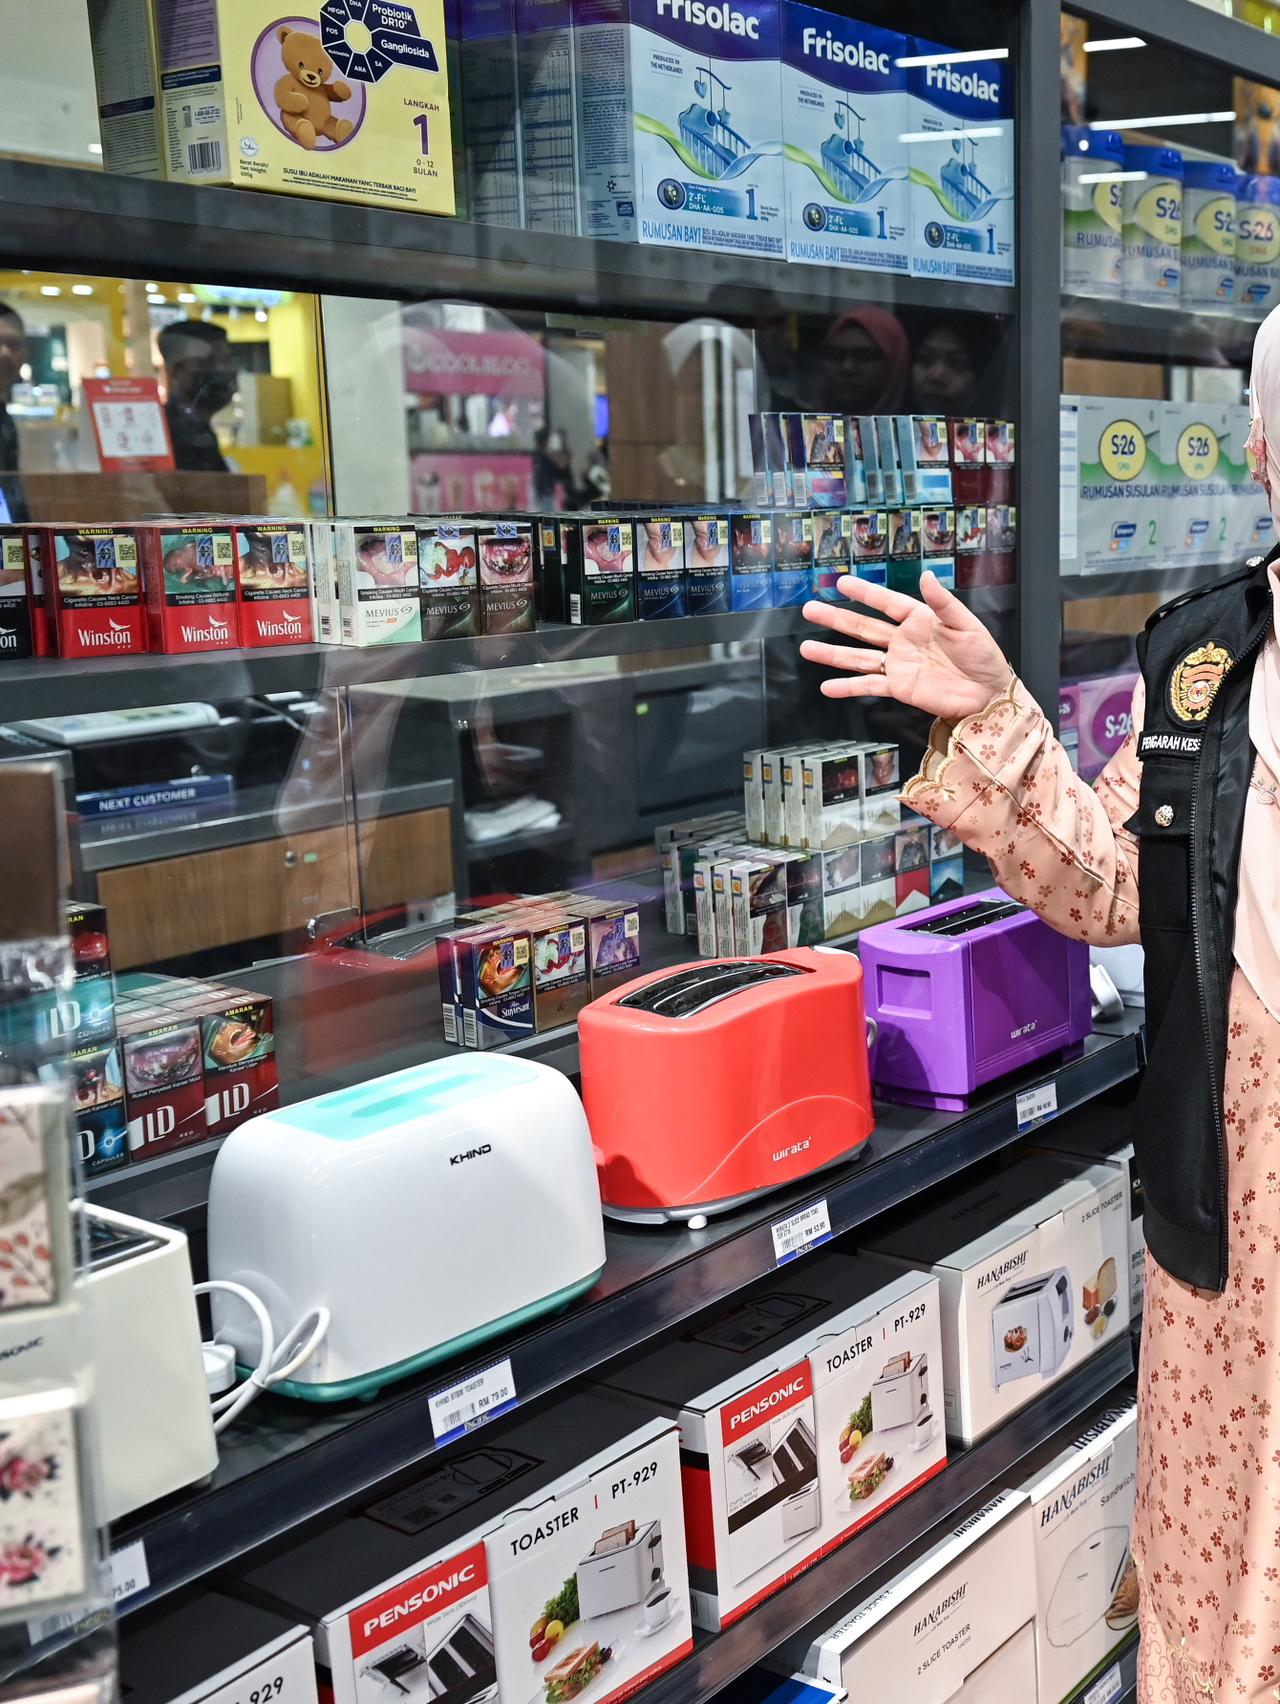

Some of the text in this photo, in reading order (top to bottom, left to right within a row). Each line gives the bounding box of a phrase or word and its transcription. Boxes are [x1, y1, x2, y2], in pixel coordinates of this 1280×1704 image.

[372, 4, 412, 21] Probiotik
[657, 0, 759, 40] Frisolac
[326, 27, 338, 35] FOS
[381, 39, 429, 58] Gangliosida
[803, 28, 890, 75] Frisolac
[354, 65, 366, 73] ARA
[926, 62, 999, 103] Frisolac
[404, 98, 440, 112] LANGKAH
[413, 114, 429, 156] 1
[283, 168, 298, 176] SUSU
[308, 172, 330, 180] ADALAH
[330, 174, 357, 184] MAKANAN
[414, 167, 438, 177] BULAN
[746, 188, 758, 221] 1
[643, 220, 683, 241] RUMUSAN
[684, 226, 700, 244] BAYI
[877, 210, 887, 240] 1
[791, 242, 824, 260] RUMUSAN
[987, 228, 996, 255] 1
[1082, 485, 1160, 499] RUMUSAN SUSULAN
[1162, 485, 1198, 498] RUMUSAN
[1148, 520, 1157, 545] 2
[591, 591, 617, 600] MEVIUS
[644, 588, 670, 596] MEVIUS
[366, 607, 399, 618] MEVIUS
[426, 606, 458, 616] MEVIUS
[486, 601, 516, 611] MEVIUS
[78, 628, 131, 646] Winston
[182, 626, 228, 643] Winston
[257, 620, 302, 636] Winston
[1142, 735, 1180, 750] PENGARAH
[100, 788, 196, 812] NEXT CUSTOMER
[225, 1005, 253, 1017] AMARAN
[148, 1024, 178, 1037] AMARAN
[1010, 1022, 1036, 1039] wirata
[223, 1083, 250, 1118] LD
[146, 1106, 175, 1143] LD
[450, 1144, 492, 1166] KHIND
[773, 1138, 811, 1162] wirata
[1086, 1206, 1100, 1221] SLICE
[1100, 1191, 1123, 1211] TOASTER
[805, 1228, 813, 1238] RM
[977, 1252, 1027, 1290] HANABISHI
[826, 1303, 926, 1373] TOASTER PT-929
[478, 1397, 490, 1407] RM
[730, 1376, 804, 1431] PENSONIC
[611, 1461, 659, 1500] PT-929
[1041, 1456, 1110, 1528] HANABISHI
[1100, 1472, 1135, 1507] Sandwich
[953, 1496, 1006, 1538] HANABISHI
[510, 1506, 580, 1556] TOASTER
[364, 1564, 476, 1638] PENSONIC
[914, 1583, 967, 1638] HANABISHI
[831, 1612, 866, 1640] TOASTER
[922, 1649, 941, 1671] SLICE
[942, 1624, 971, 1653] TOASTER
